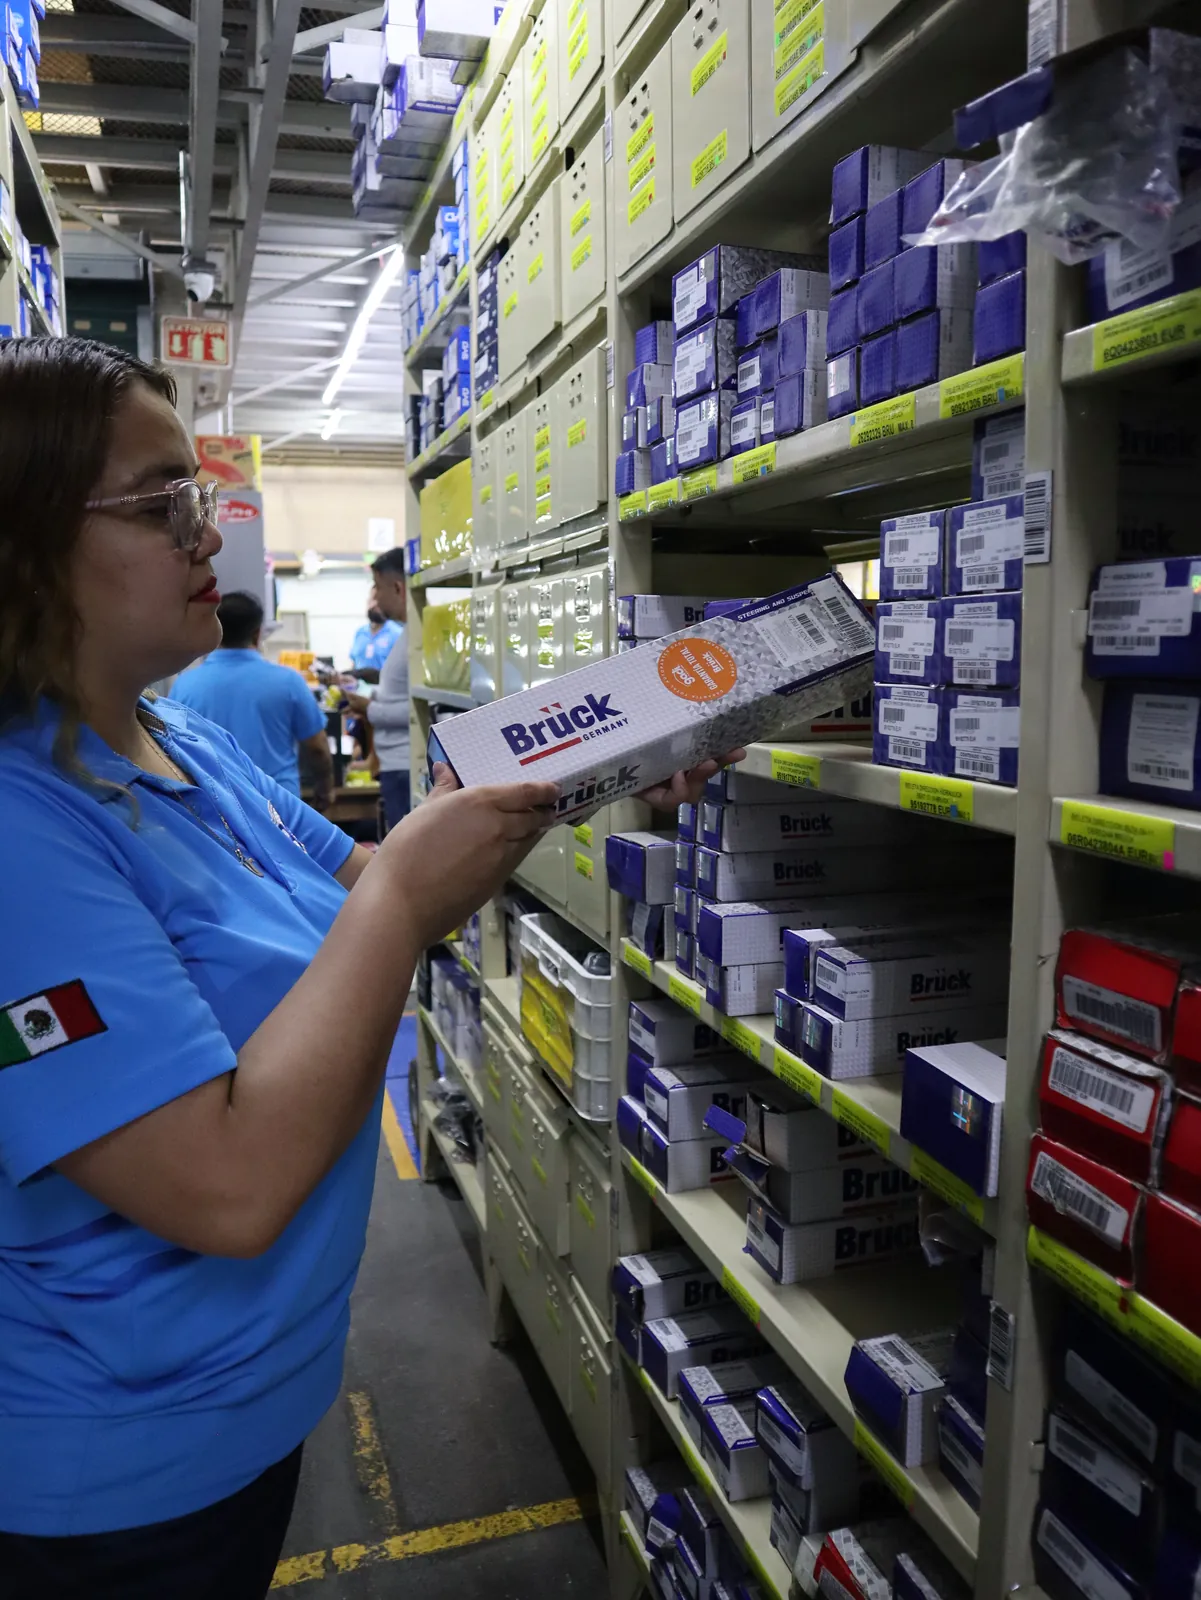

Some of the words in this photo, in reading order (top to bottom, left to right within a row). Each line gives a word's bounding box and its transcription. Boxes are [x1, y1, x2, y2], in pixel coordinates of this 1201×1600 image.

[981, 392, 999, 406] BRU
[881, 423, 895, 437] BRU
[737, 605, 771, 622] STEERING
[772, 598, 785, 608] AND
[679, 646, 697, 664] TOTAL
[701, 651, 722, 674] Brück
[500, 693, 623, 757] Brück
[582, 717, 630, 741] GERMANY
[548, 764, 641, 812] rück
[595, 781, 640, 803] GERMANY
[780, 813, 832, 833] Brück
[774, 859, 826, 880] Brück
[911, 968, 972, 994] Brück
[898, 1026, 958, 1055] Brück
[835, 1212, 920, 1259] Brüc
